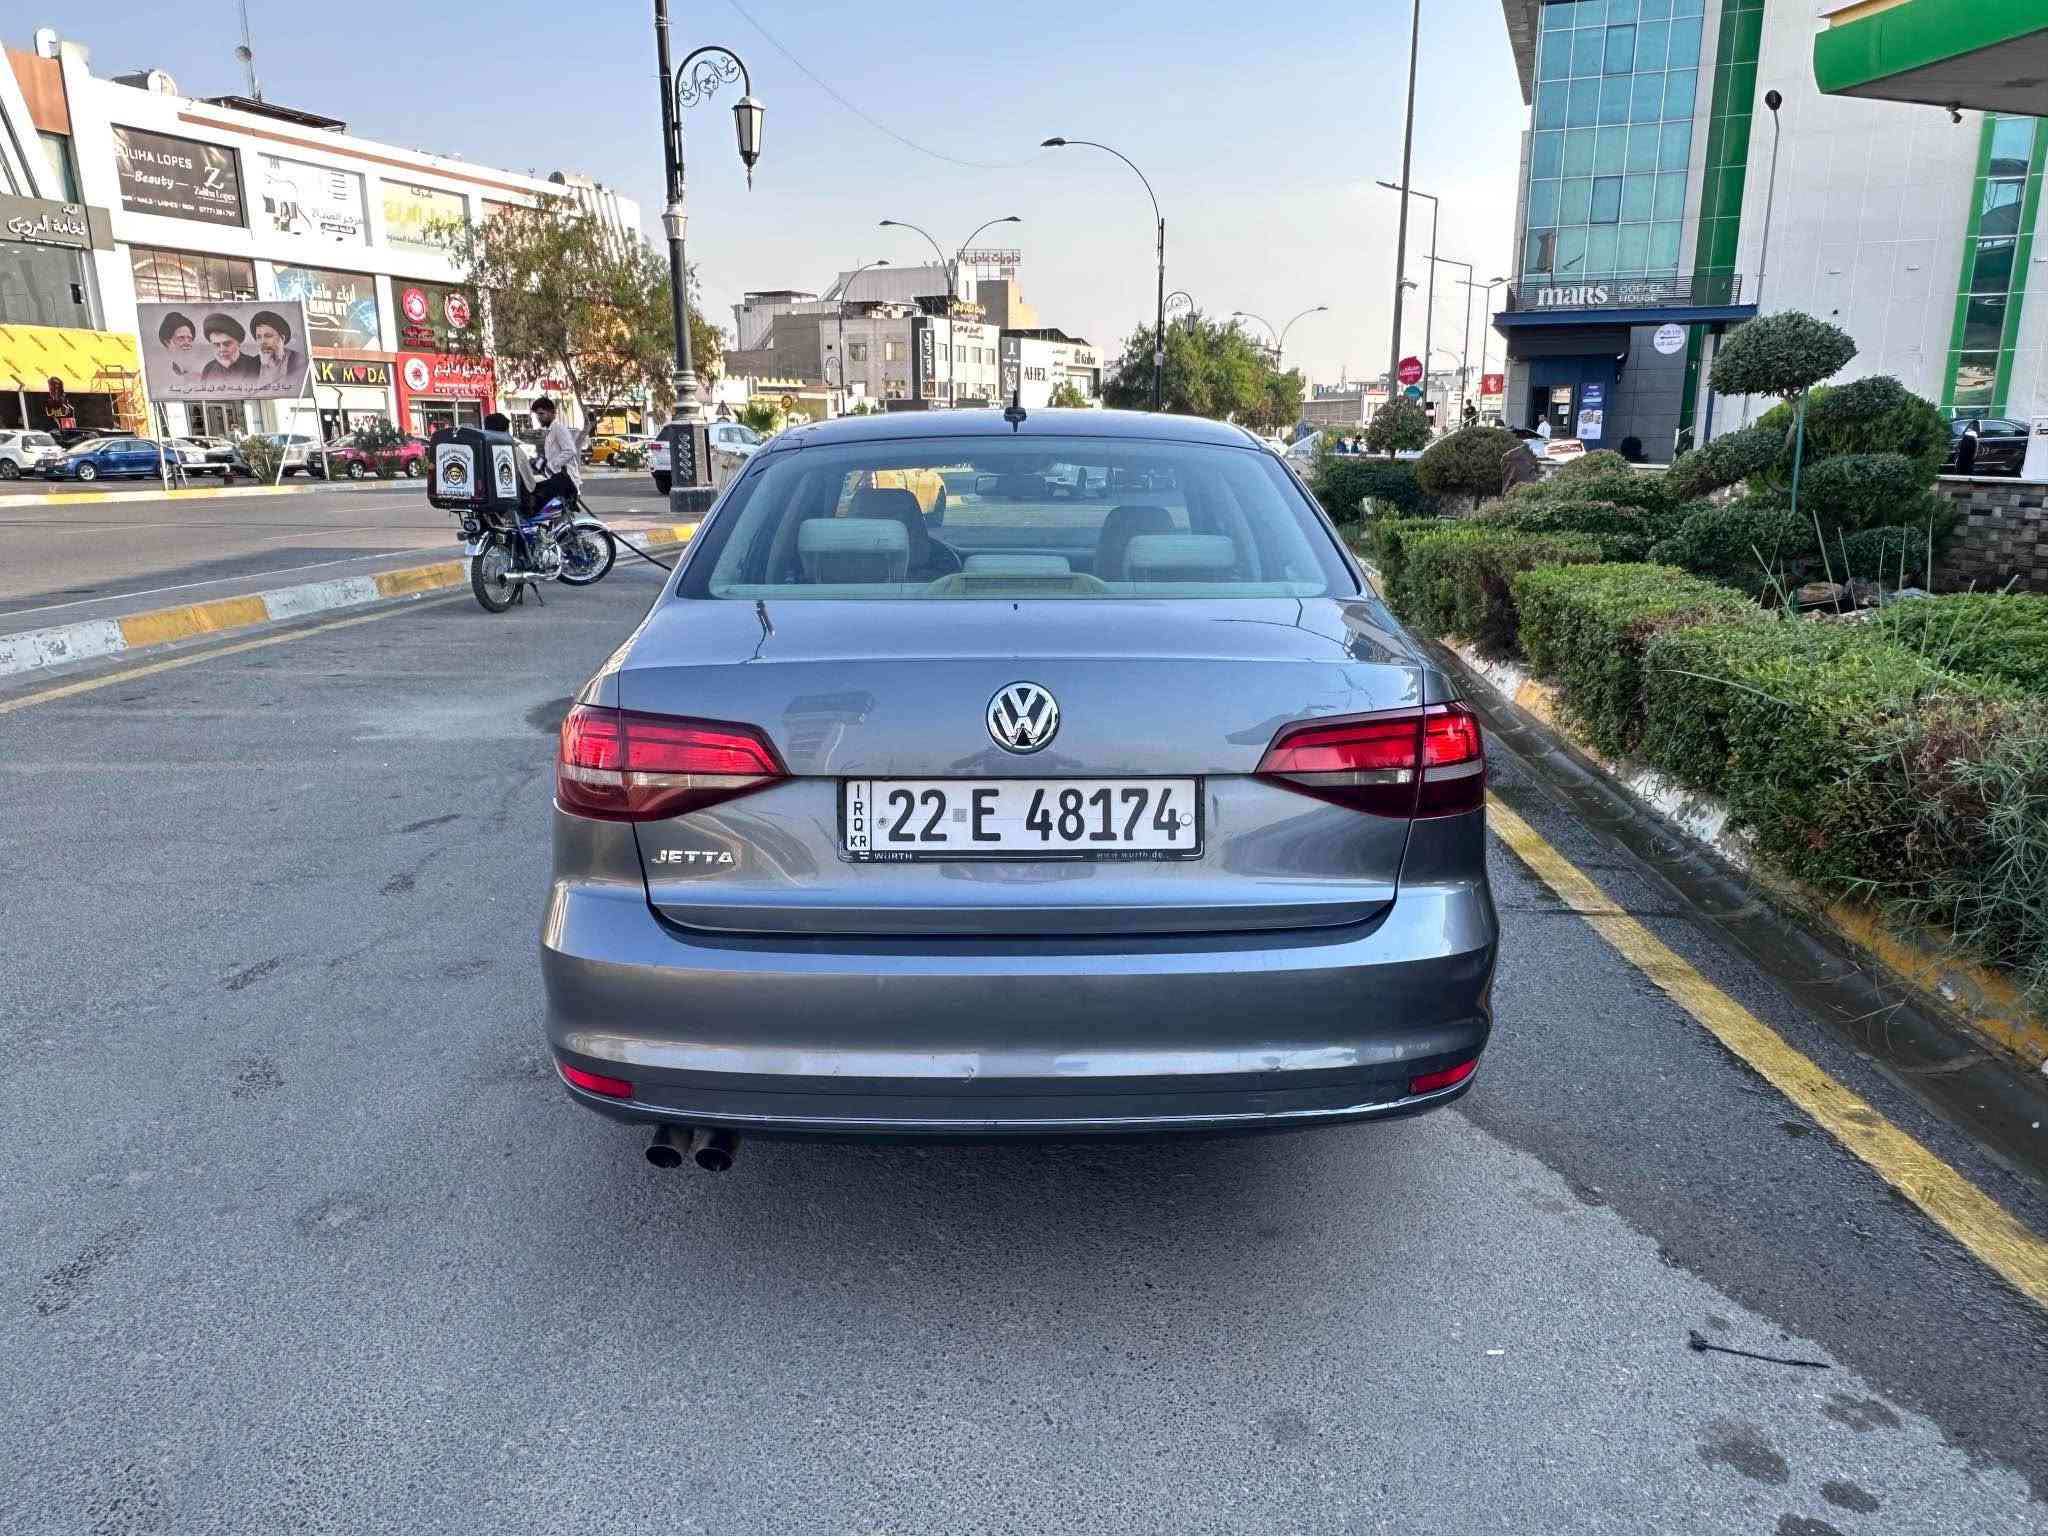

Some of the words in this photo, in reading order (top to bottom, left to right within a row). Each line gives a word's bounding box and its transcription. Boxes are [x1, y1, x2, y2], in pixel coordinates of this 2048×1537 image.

[157, 152, 193, 169] LOPES
[888, 788, 947, 842] 22
[972, 788, 1001, 842] E
[1024, 788, 1181, 842] 48174
[650, 849, 734, 864] JETTA
